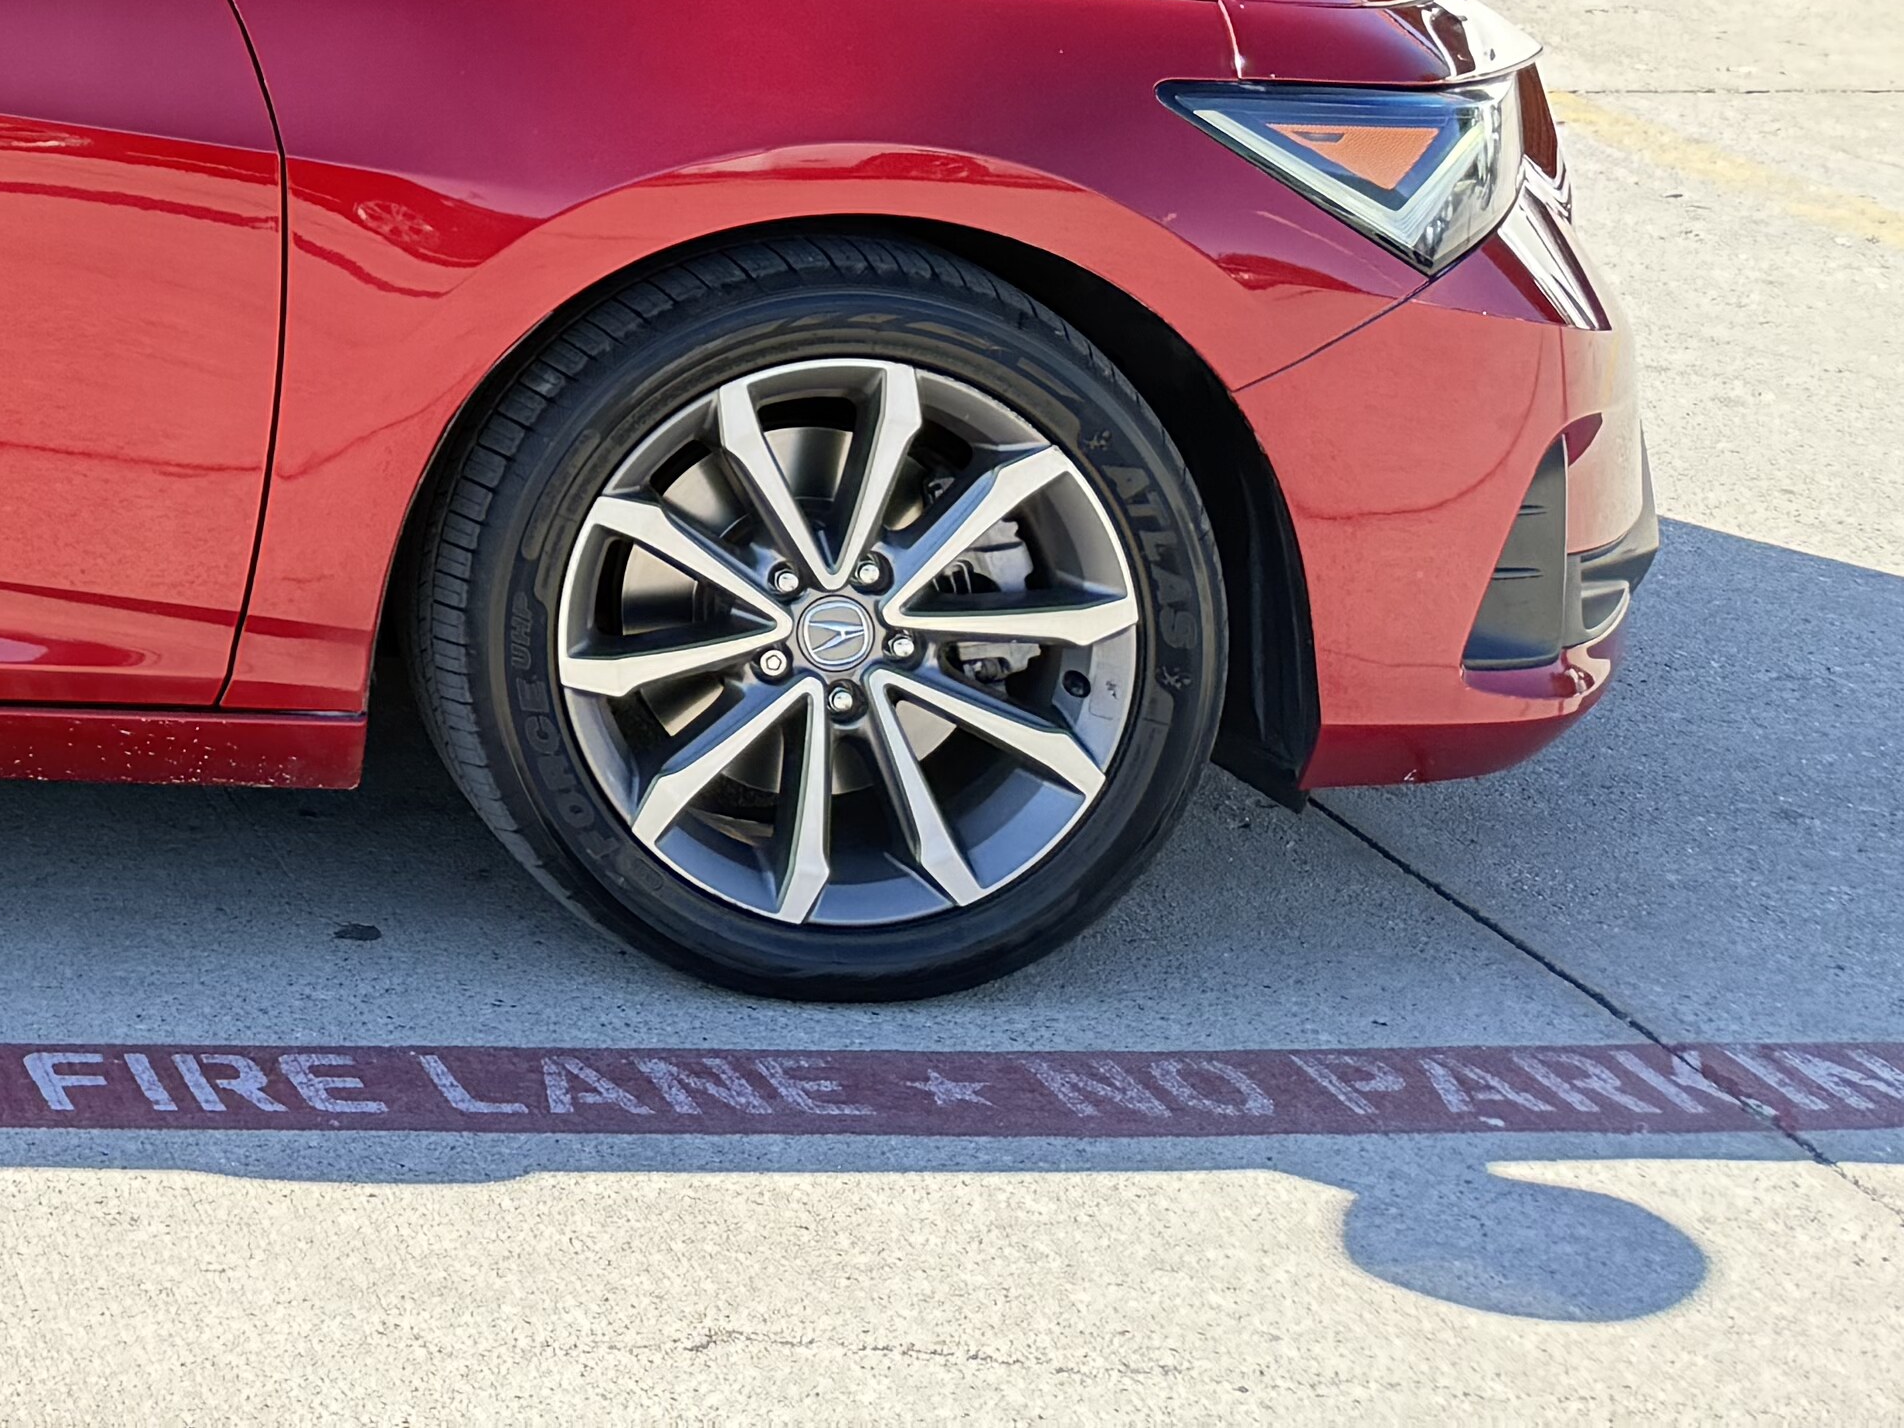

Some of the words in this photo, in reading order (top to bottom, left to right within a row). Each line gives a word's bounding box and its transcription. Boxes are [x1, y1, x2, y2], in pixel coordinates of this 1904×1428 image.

[1101, 464, 1197, 649] ATLAS
[22, 1051, 390, 1113] FIRE
[418, 1053, 878, 1117] LANE
[1010, 1054, 1275, 1118] NO
